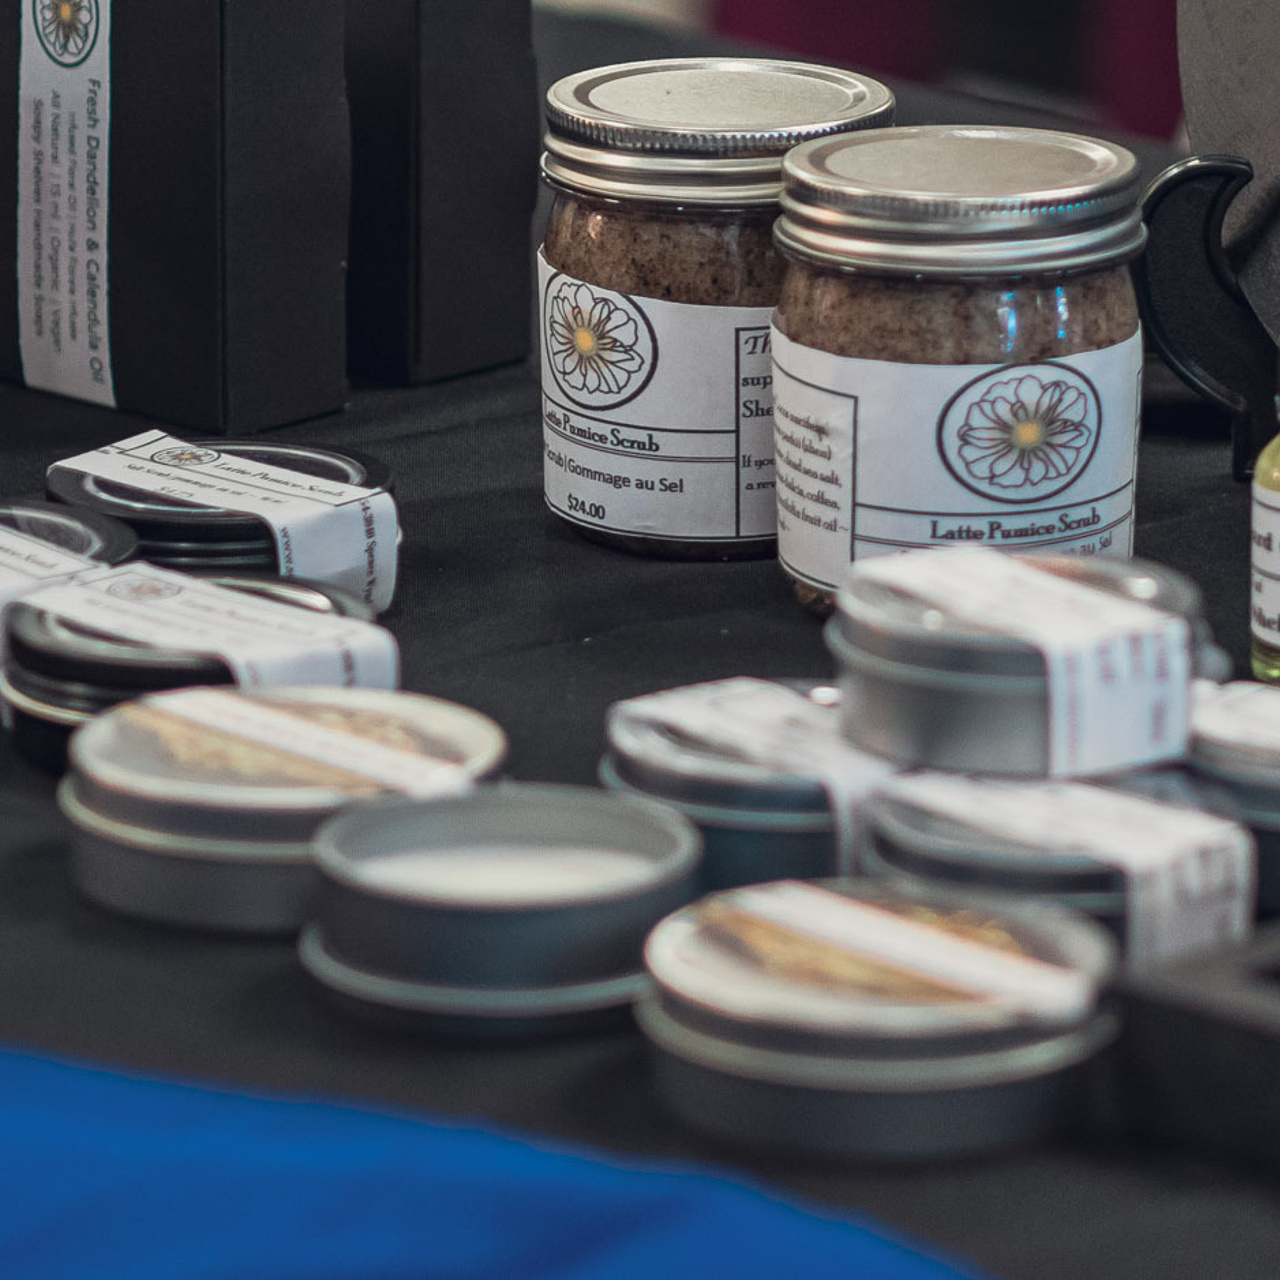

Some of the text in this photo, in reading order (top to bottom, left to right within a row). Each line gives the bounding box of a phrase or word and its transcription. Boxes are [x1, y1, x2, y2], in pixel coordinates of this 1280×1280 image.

[86, 76, 106, 385] Fresh Dandelion & Calendula Oil
[741, 399, 774, 419] She
[562, 413, 608, 445] Pumice
[610, 428, 660, 452] Scrub
[741, 454, 751, 468] If
[634, 479, 655, 492] au
[659, 478, 684, 493] Sel
[745, 481, 754, 490] a
[567, 493, 606, 520] $24.00
[929, 507, 1102, 541] Latte Pumice Scrub
[1098, 532, 1114, 551] Sel
